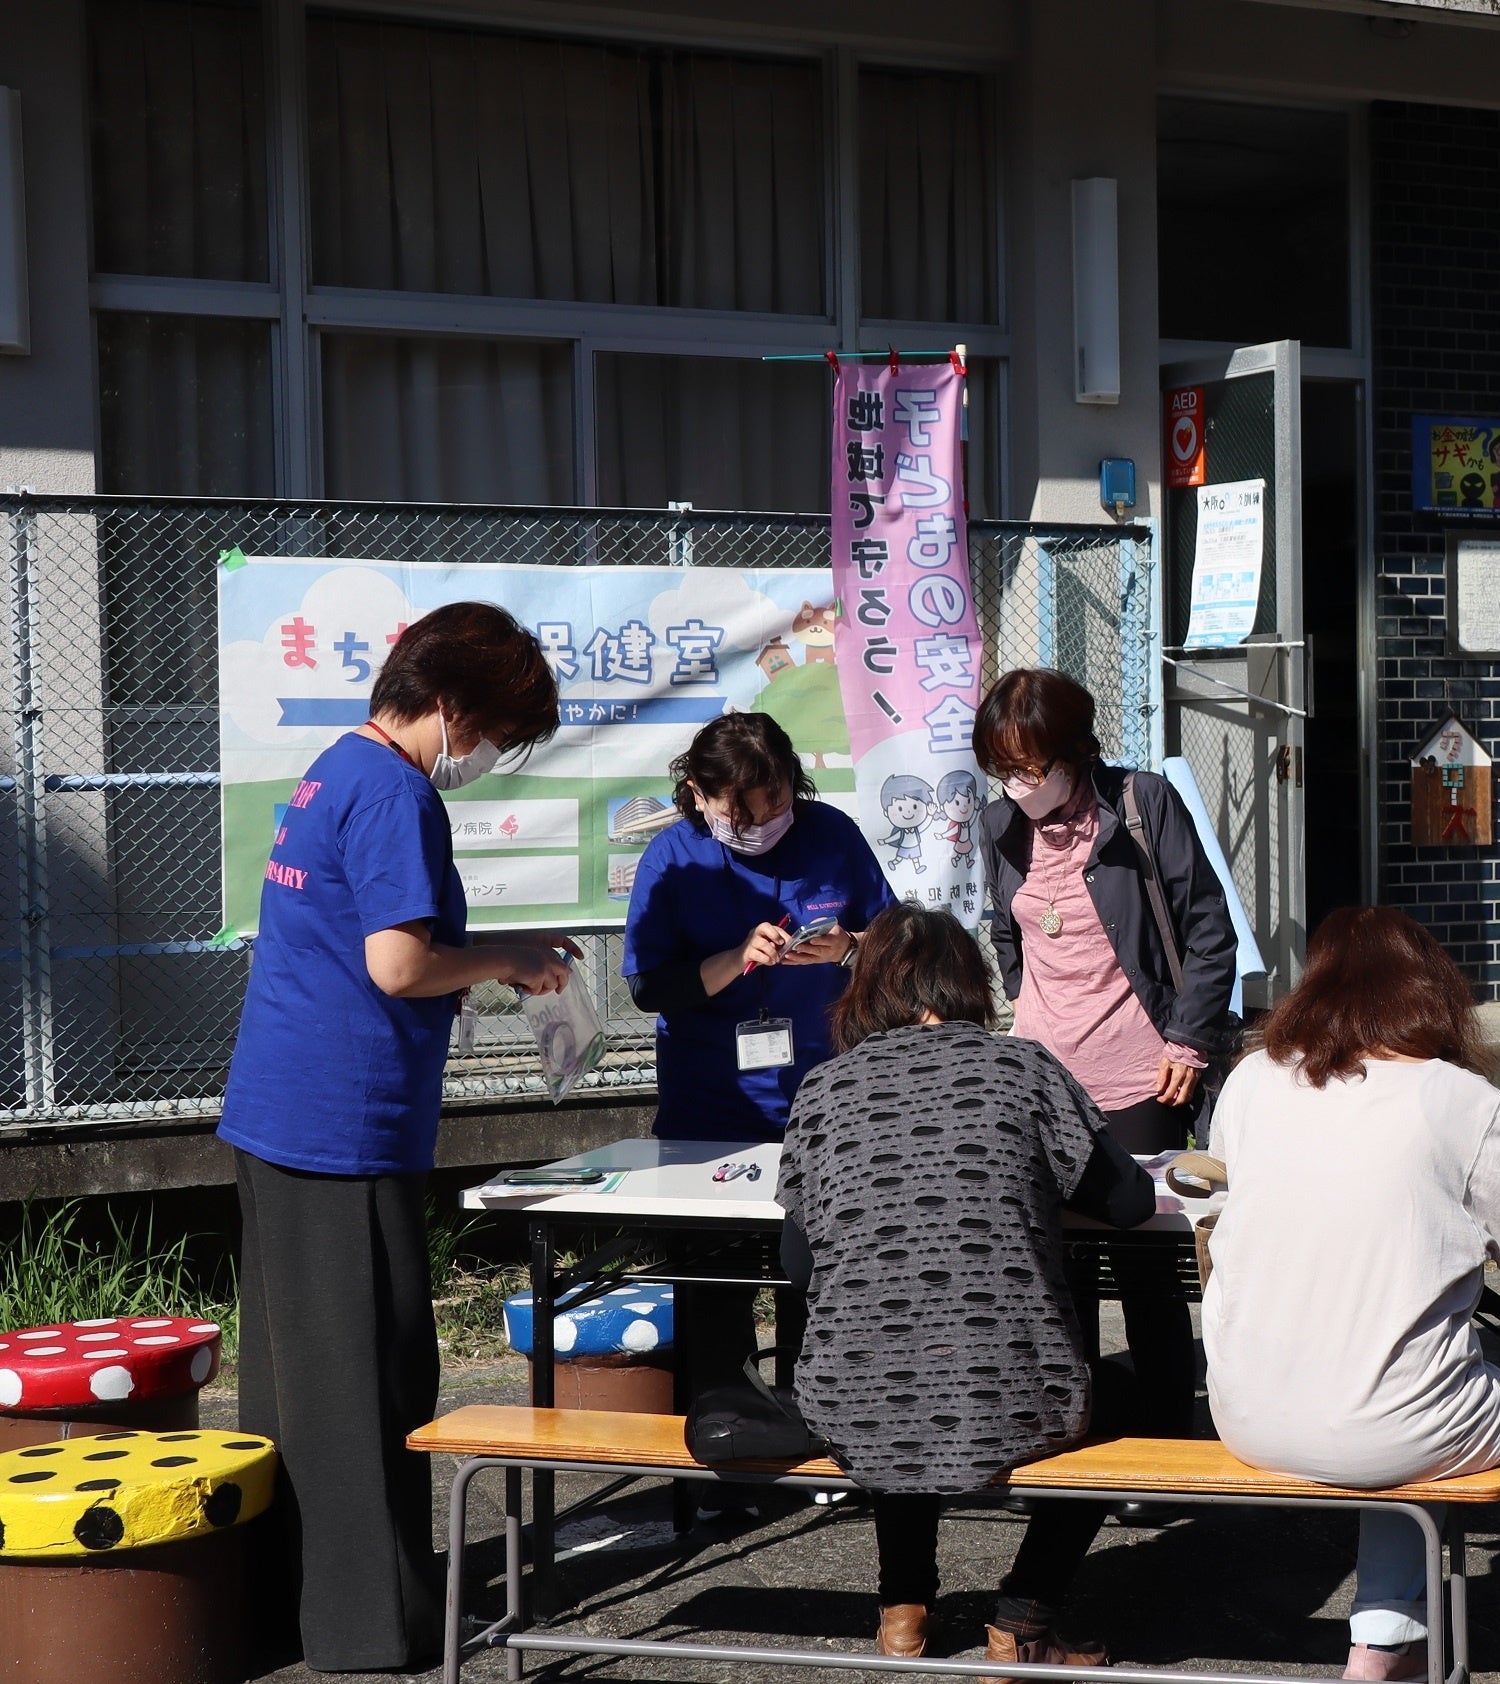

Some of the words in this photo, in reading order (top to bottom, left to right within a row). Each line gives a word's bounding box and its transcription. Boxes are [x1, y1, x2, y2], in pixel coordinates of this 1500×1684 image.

[1172, 391, 1197, 409] AED
[558, 703, 639, 721] やかに！
